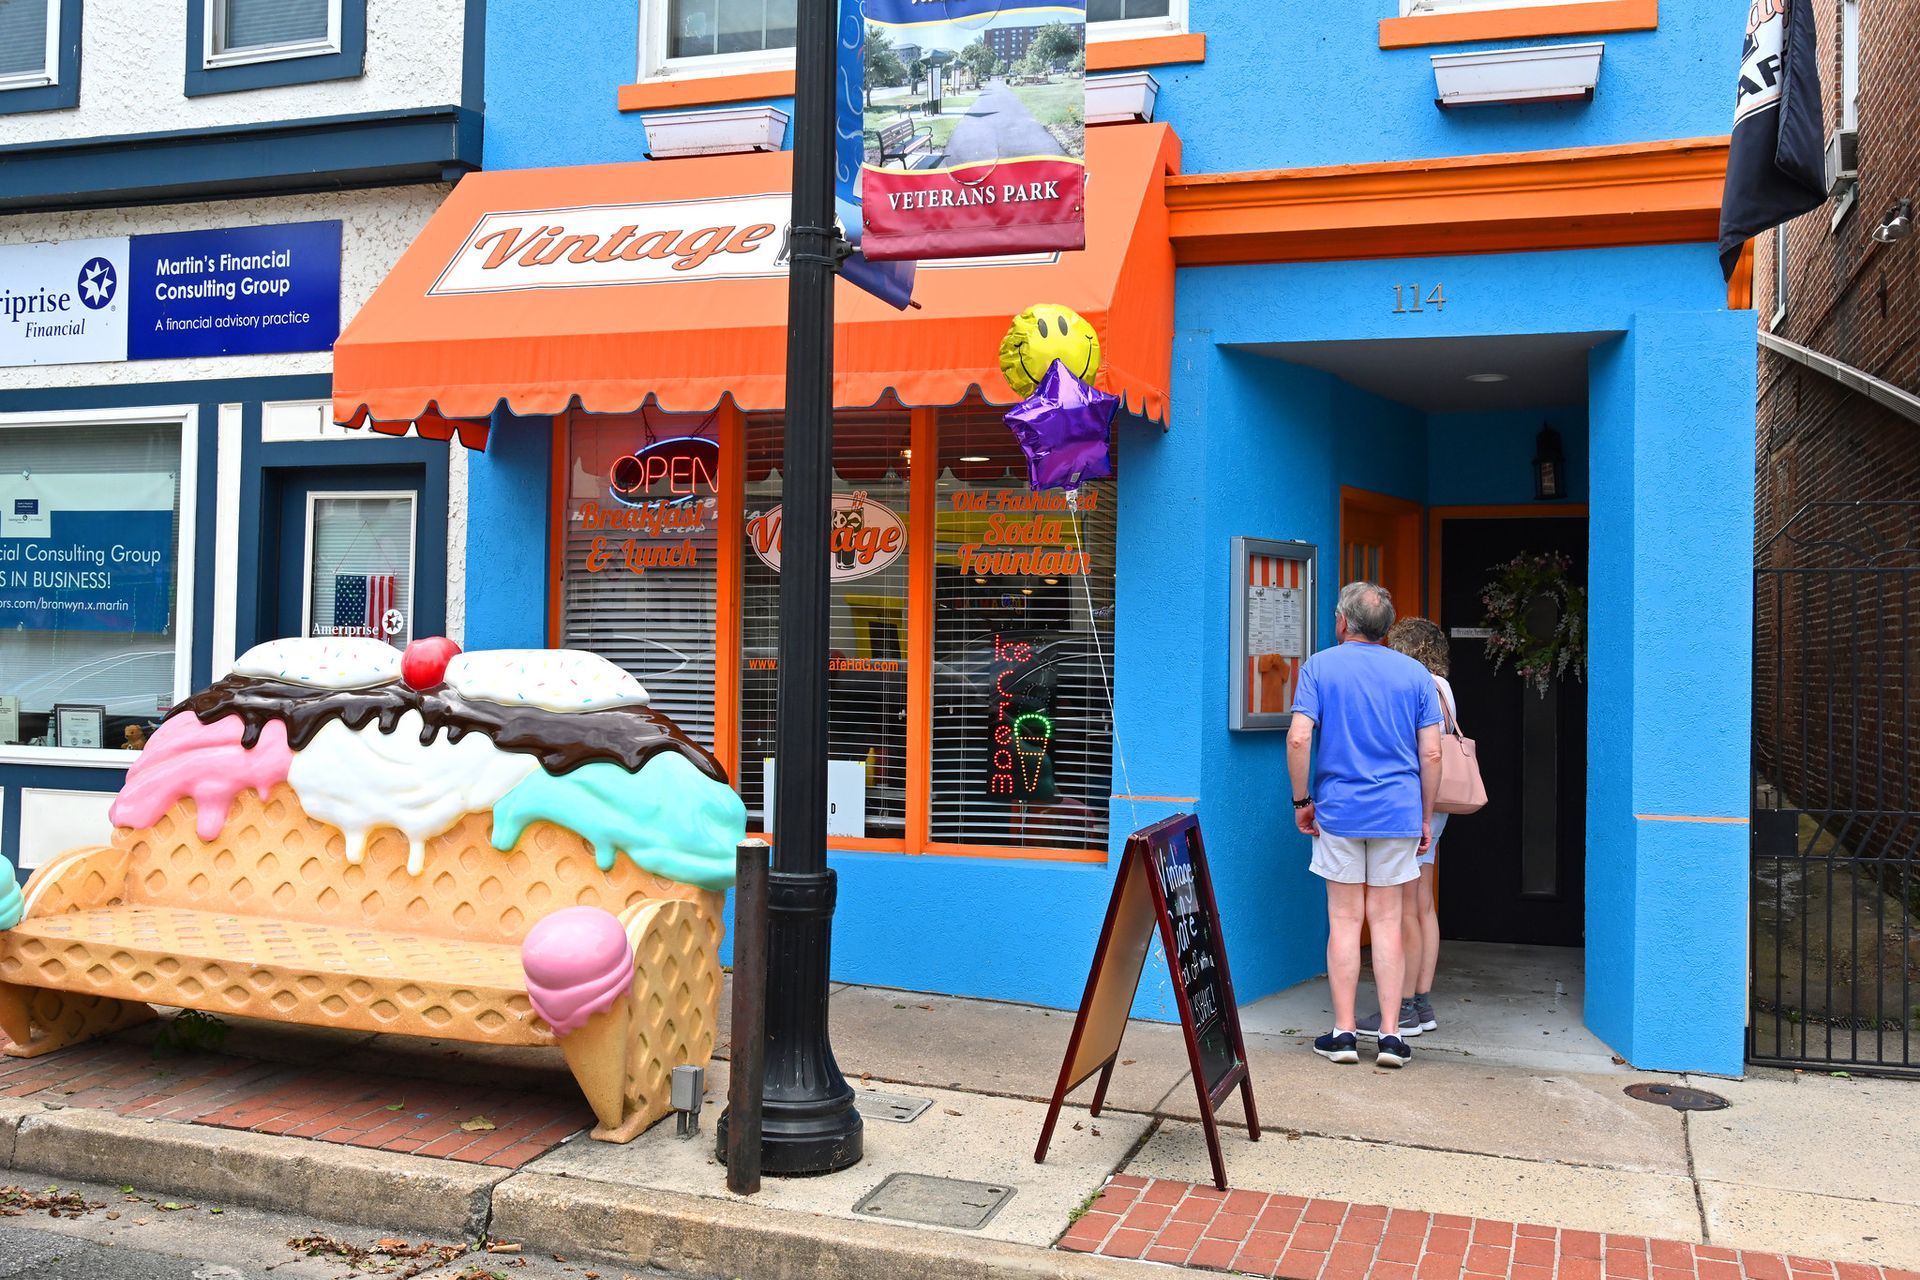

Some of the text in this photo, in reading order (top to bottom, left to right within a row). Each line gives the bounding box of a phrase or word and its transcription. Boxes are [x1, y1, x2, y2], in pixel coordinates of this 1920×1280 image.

[888, 181, 1060, 210] VETERANS PARK
[156, 249, 291, 276] Martin's Financial
[474, 223, 776, 271] Vintage
[155, 277, 290, 300] Consulting Group
[1391, 282, 1447, 313] 114
[0, 287, 71, 322] iprise
[25, 318, 85, 338] Financial
[155, 311, 310, 331] A financial advisory practice
[609, 455, 719, 494] OPEN
[579, 500, 704, 537] Breakfast
[984, 513, 1062, 546] Soda
[25, 544, 105, 566] Consulting
[111, 545, 161, 566] Group
[586, 535, 698, 575] & Lunch
[746, 516, 901, 564] Vage
[957, 544, 1092, 576] Fountain
[11, 571, 27, 587] IN
[33, 571, 111, 589] BUSINESS!
[312, 623, 379, 637] Ameriprise
[995, 634, 1032, 663] Ice
[991, 670, 1014, 793] Cream
[1154, 844, 1195, 903] Vintage
